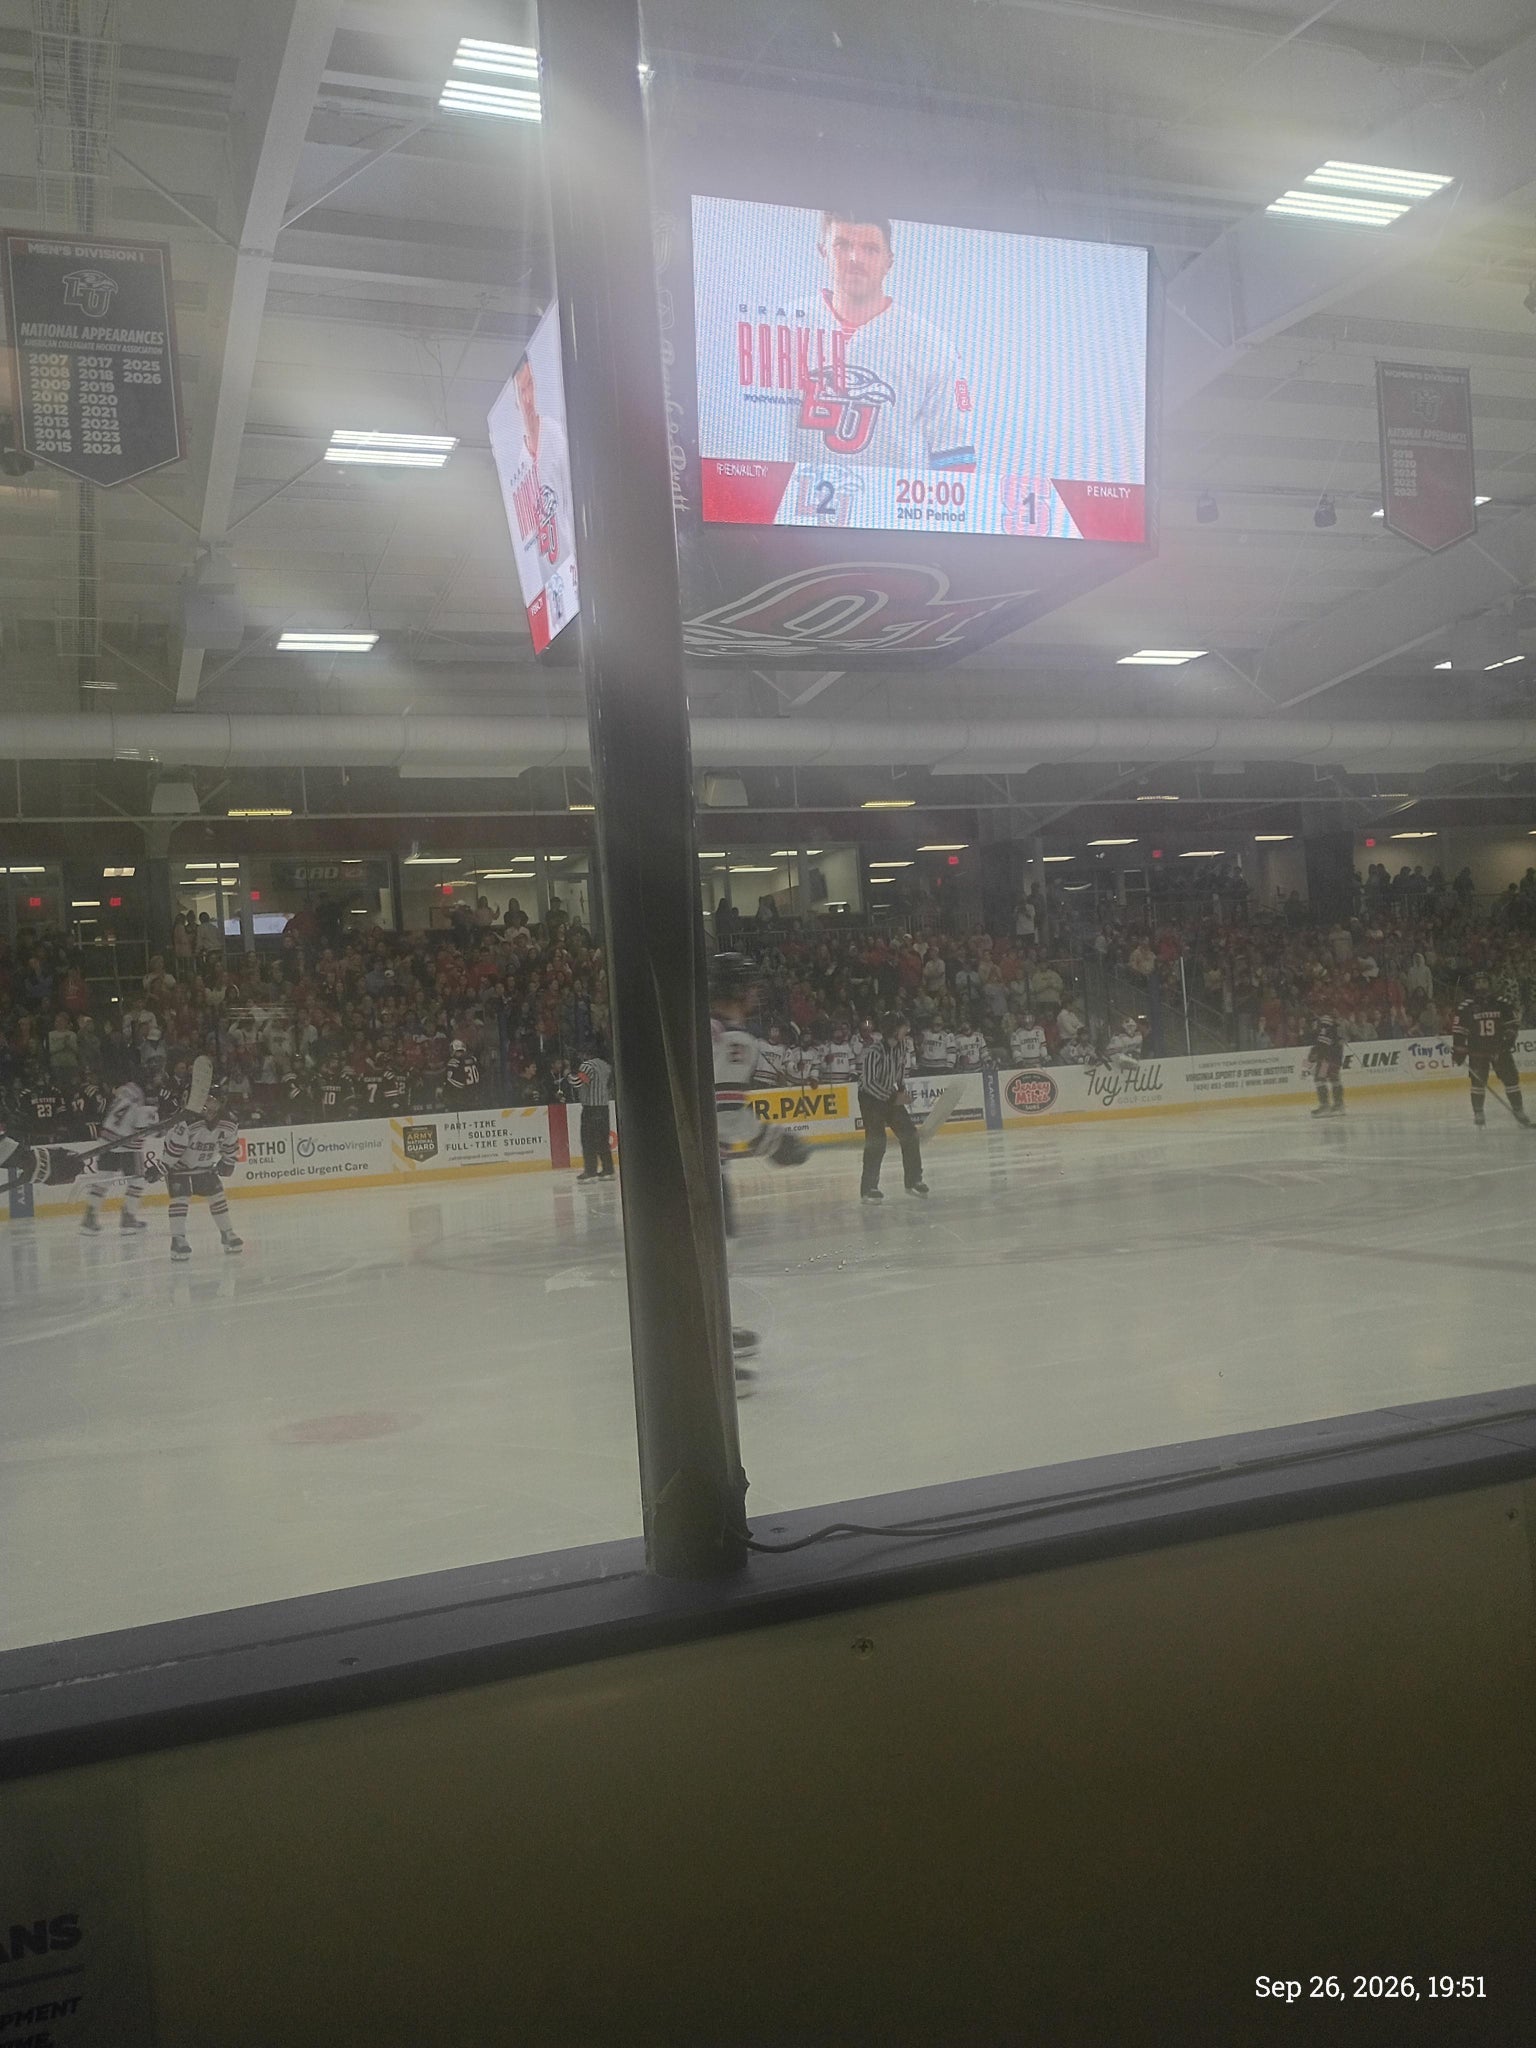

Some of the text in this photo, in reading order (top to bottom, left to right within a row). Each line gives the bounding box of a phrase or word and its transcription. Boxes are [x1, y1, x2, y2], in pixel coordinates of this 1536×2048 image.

[28, 242, 72, 257] MEN'S
[75, 247, 136, 262] DIVISION
[738, 303, 806, 319] BRAD
[20, 322, 164, 345] NATIONAL APPEARANCES
[29, 353, 69, 366] 2007
[77, 355, 113, 368] 2017
[122, 358, 160, 371] 2025
[738, 320, 847, 397] BARKER
[30, 366, 70, 378] 2008
[79, 368, 114, 381] 2018
[123, 371, 162, 384] 2026
[31, 378, 71, 390] 2009
[79, 381, 115, 393] 2019
[31, 390, 69, 403] 2010
[79, 393, 118, 406] 2020
[32, 403, 69, 416] 2012
[81, 405, 118, 418] 2021
[34, 415, 70, 428] 2013
[81, 418, 120, 431] 2022
[35, 427, 72, 440] 2014
[82, 430, 121, 443] 2023
[36, 440, 72, 453] 2015
[82, 442, 122, 455] 2024
[717, 462, 769, 478] PENALTY
[816, 480, 836, 515] 2
[896, 479, 966, 506] 20:00
[1087, 485, 1131, 499] PENALTY
[897, 507, 966, 522] 2ND Period
[1022, 492, 1036, 525] 1
[1479, 1020, 1496, 1037] 19
[1408, 1043, 1453, 1058] Tiny To
[1362, 1050, 1401, 1068] LINE
[464, 1064, 480, 1086] 30
[1121, 1064, 1163, 1093] Hill
[323, 1092, 337, 1106] 10
[366, 1083, 378, 1104] 7
[37, 1103, 53, 1118] 23
[444, 1120, 497, 1131] PART-TIME
[407, 1131, 433, 1141] ARMY
[468, 1129, 513, 1139] SOLDIER.
[317, 1139, 383, 1152] OrthoVirginia
[407, 1143, 435, 1152] GUARD
[445, 1136, 548, 1151] FULL-TIME STUDENT.
[246, 1162, 369, 1181] Orthopedic Urgent Care
